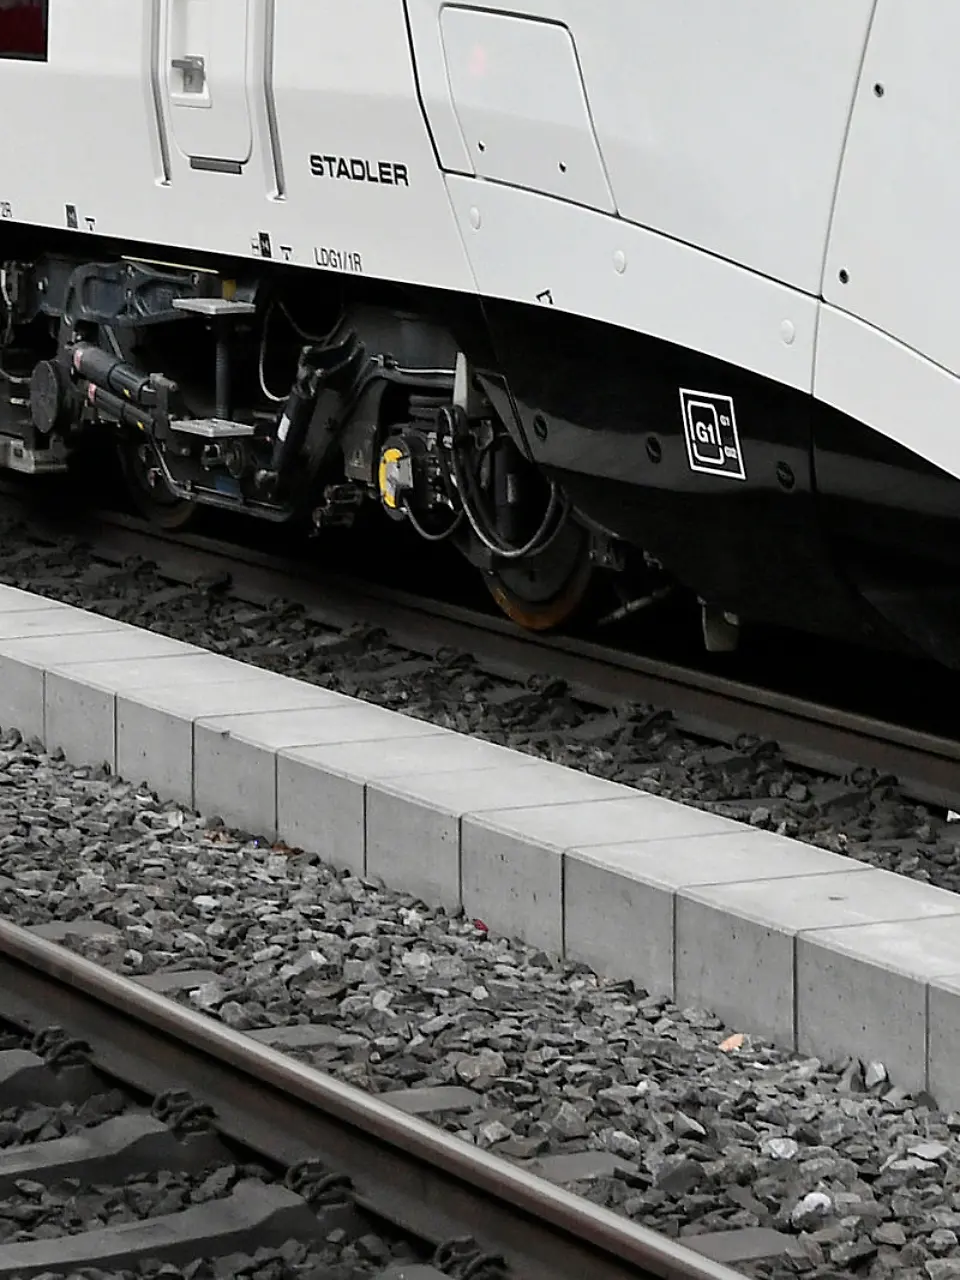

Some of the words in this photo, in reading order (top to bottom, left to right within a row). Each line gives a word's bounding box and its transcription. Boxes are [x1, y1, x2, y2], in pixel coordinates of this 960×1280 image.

[309, 154, 409, 186] STADLER
[314, 247, 362, 272] LDG1/1R
[695, 421, 716, 445] G1
